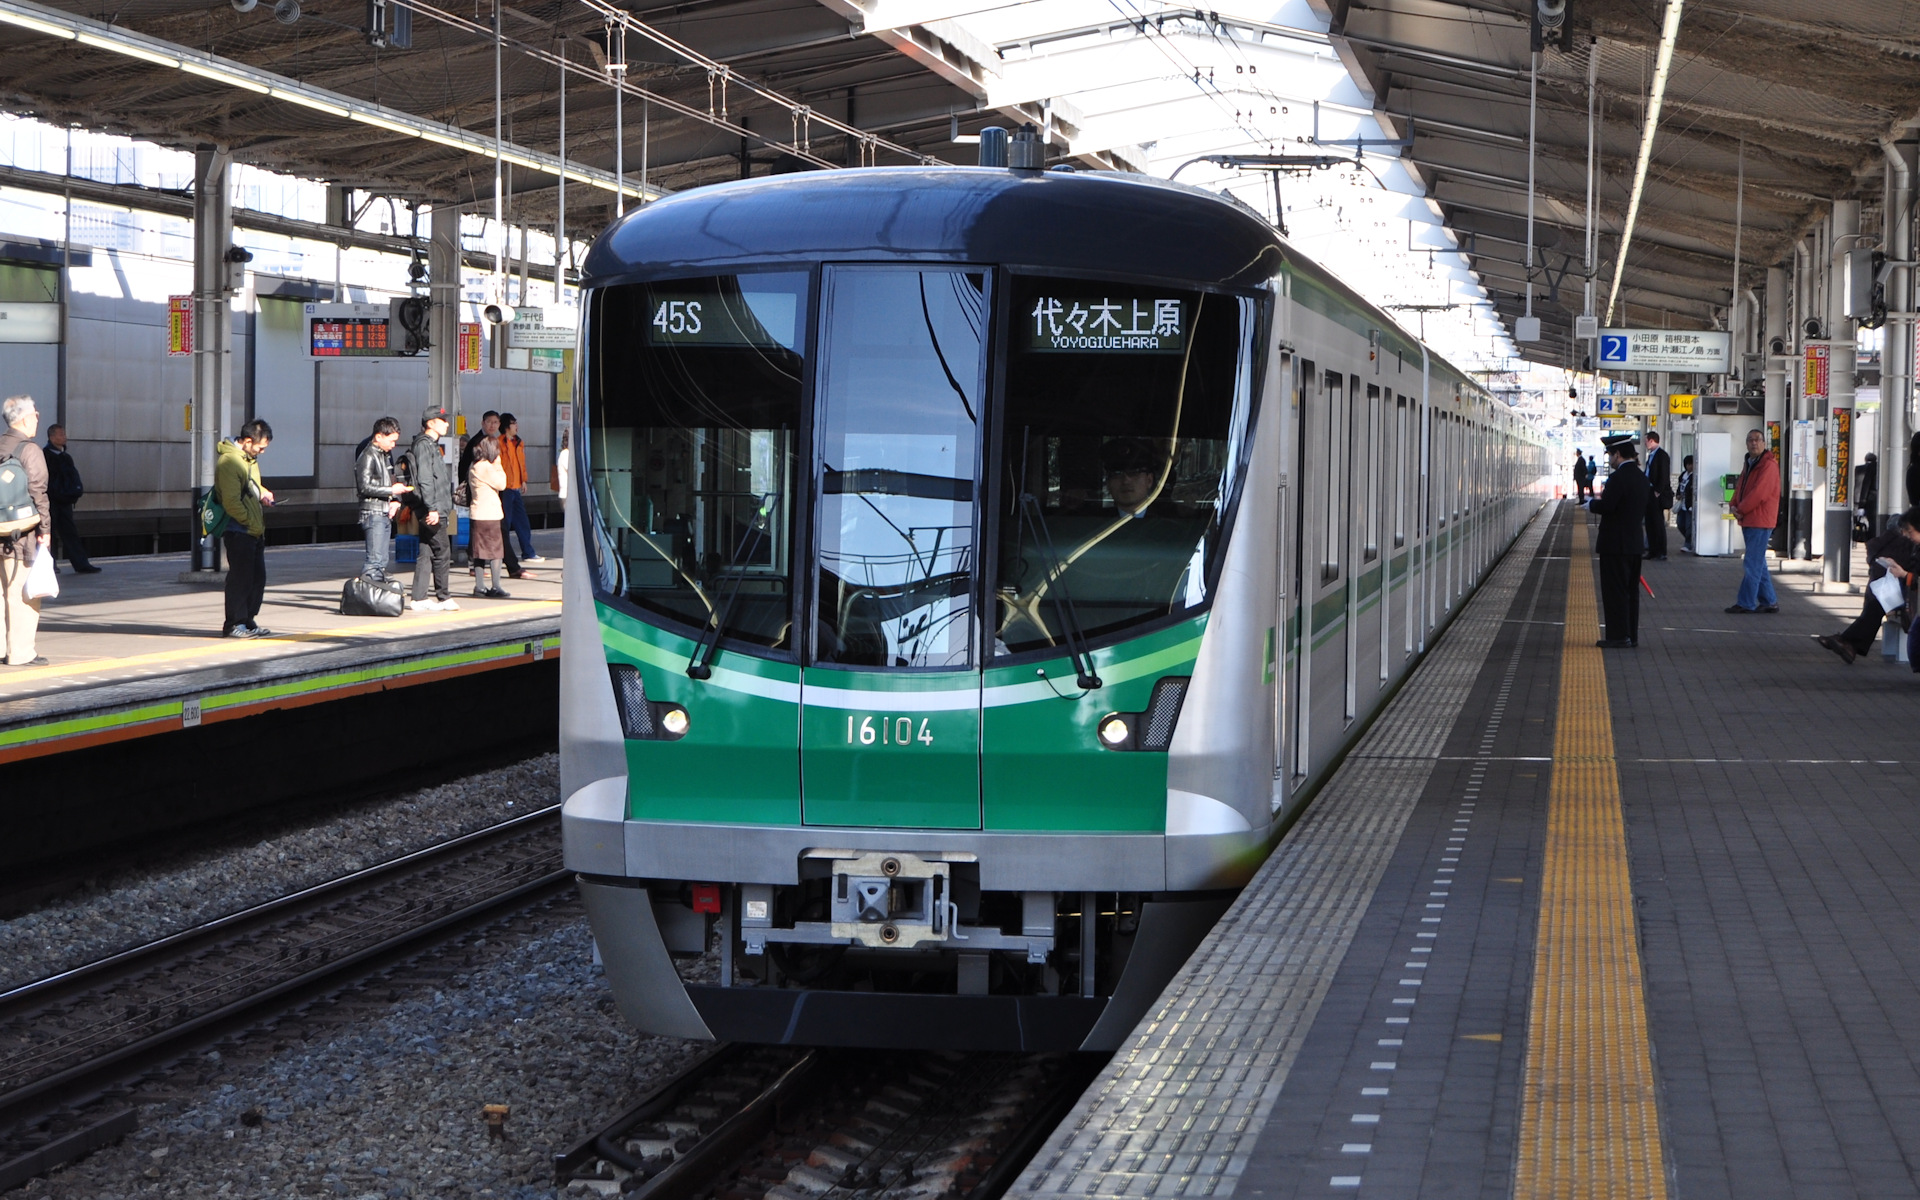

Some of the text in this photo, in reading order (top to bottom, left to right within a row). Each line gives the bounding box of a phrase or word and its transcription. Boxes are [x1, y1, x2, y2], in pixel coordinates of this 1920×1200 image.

[306, 305, 314, 313] 4
[653, 301, 702, 334] 45S
[1031, 297, 1181, 337] 代々木上原
[1051, 336, 1159, 349] YOYOGIUEHARA
[1632, 333, 1700, 344] 小田原 箱根湯本
[1606, 337, 1621, 360] 2
[1632, 344, 1721, 356] 唐木田 片瀬江ノ島 方面
[1602, 399, 1610, 411] 2
[847, 715, 934, 746] 16104
